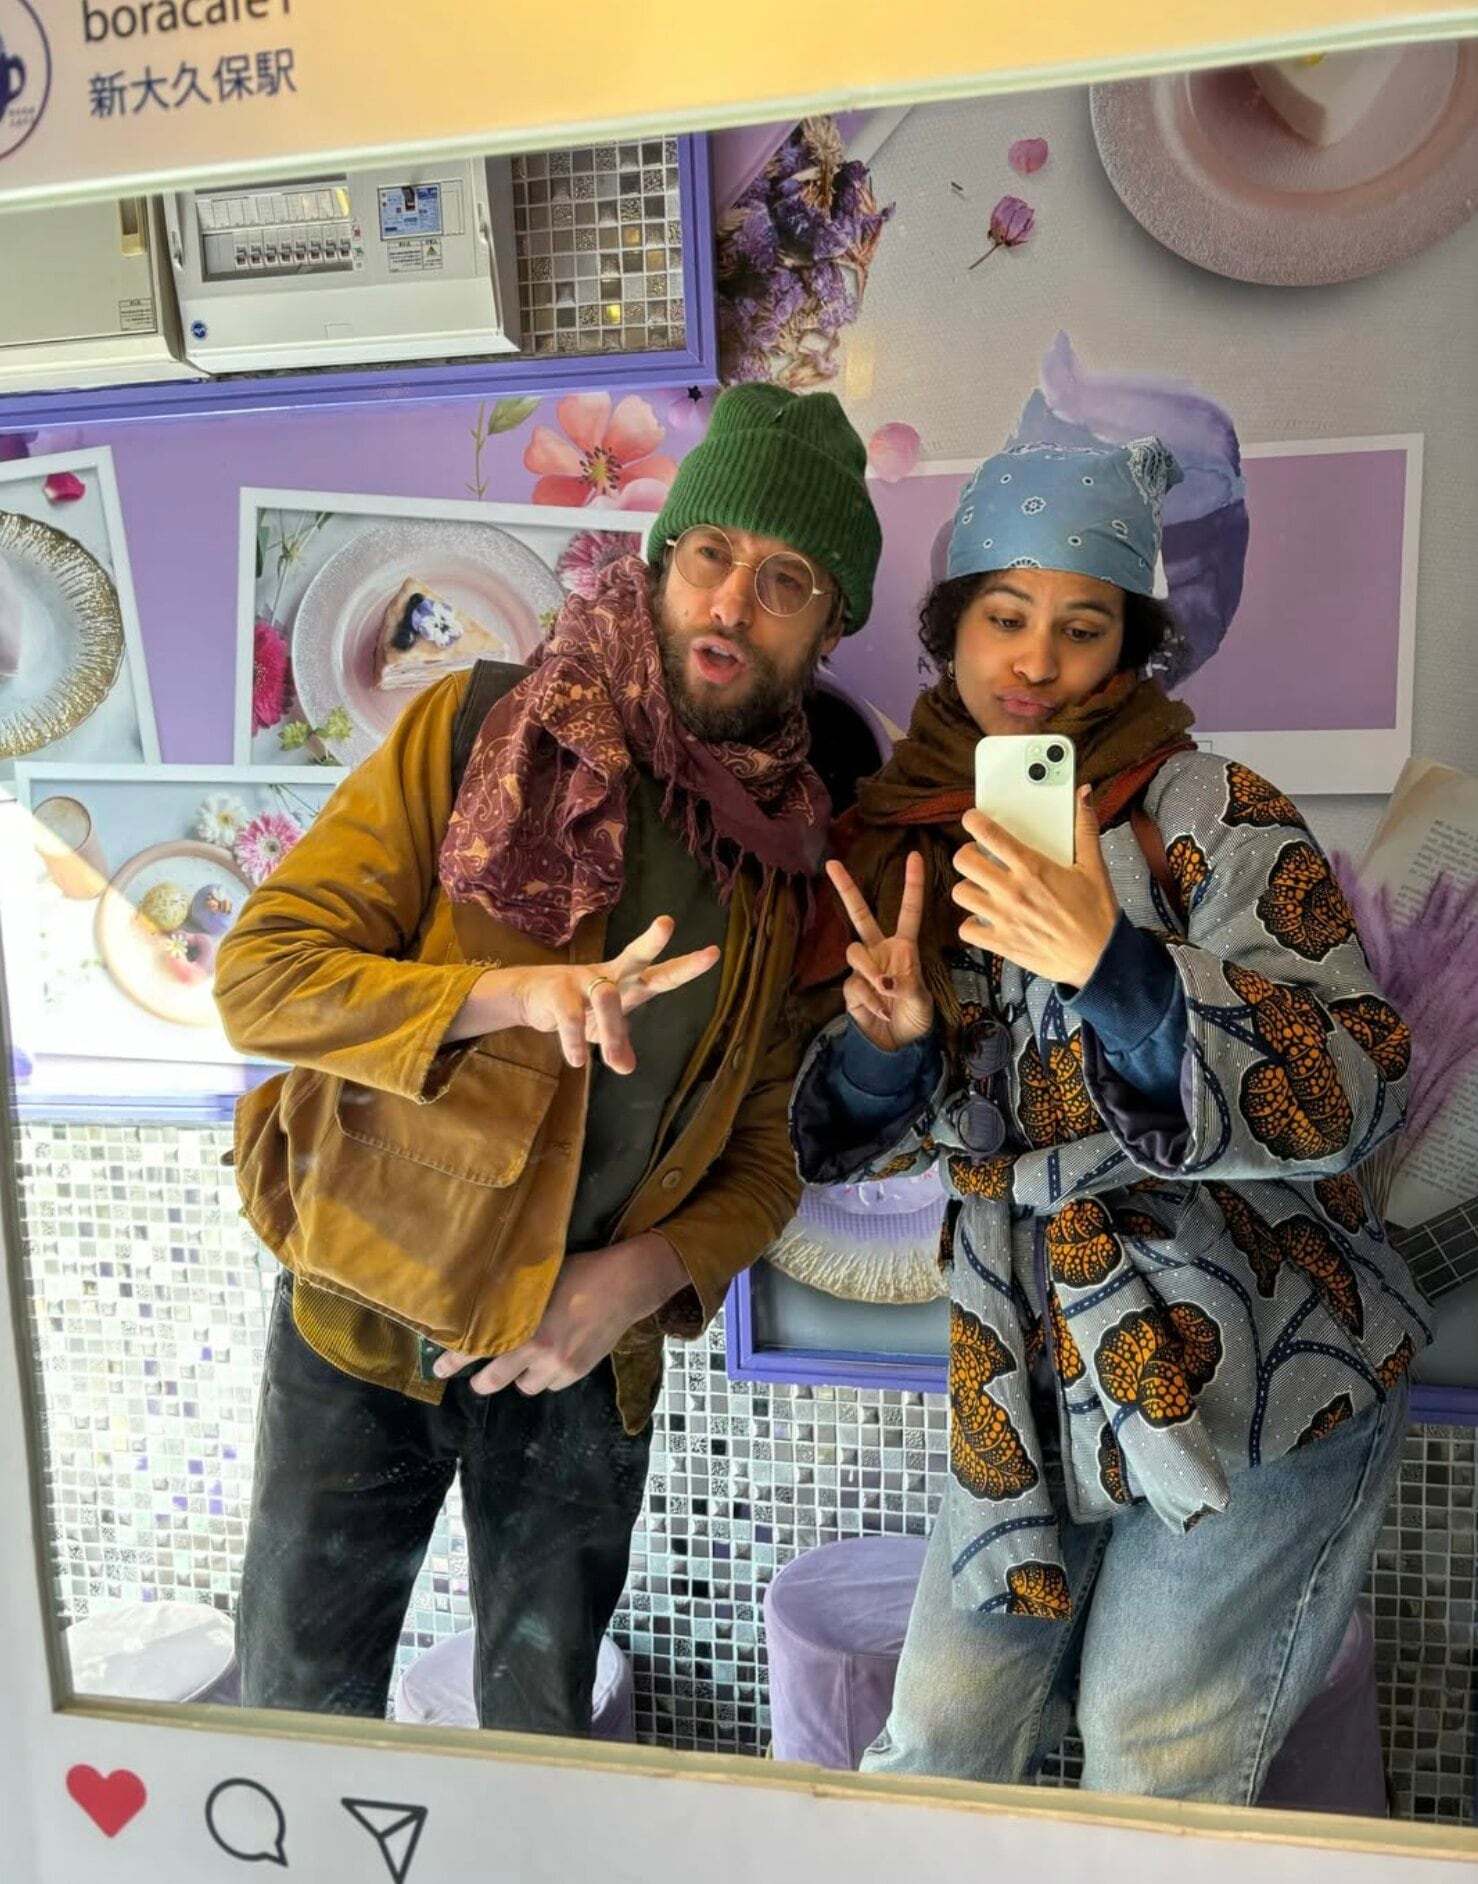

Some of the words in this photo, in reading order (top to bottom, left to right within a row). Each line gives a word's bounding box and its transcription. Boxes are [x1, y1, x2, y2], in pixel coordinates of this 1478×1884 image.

[88, 48, 297, 119] 新大久保駅
